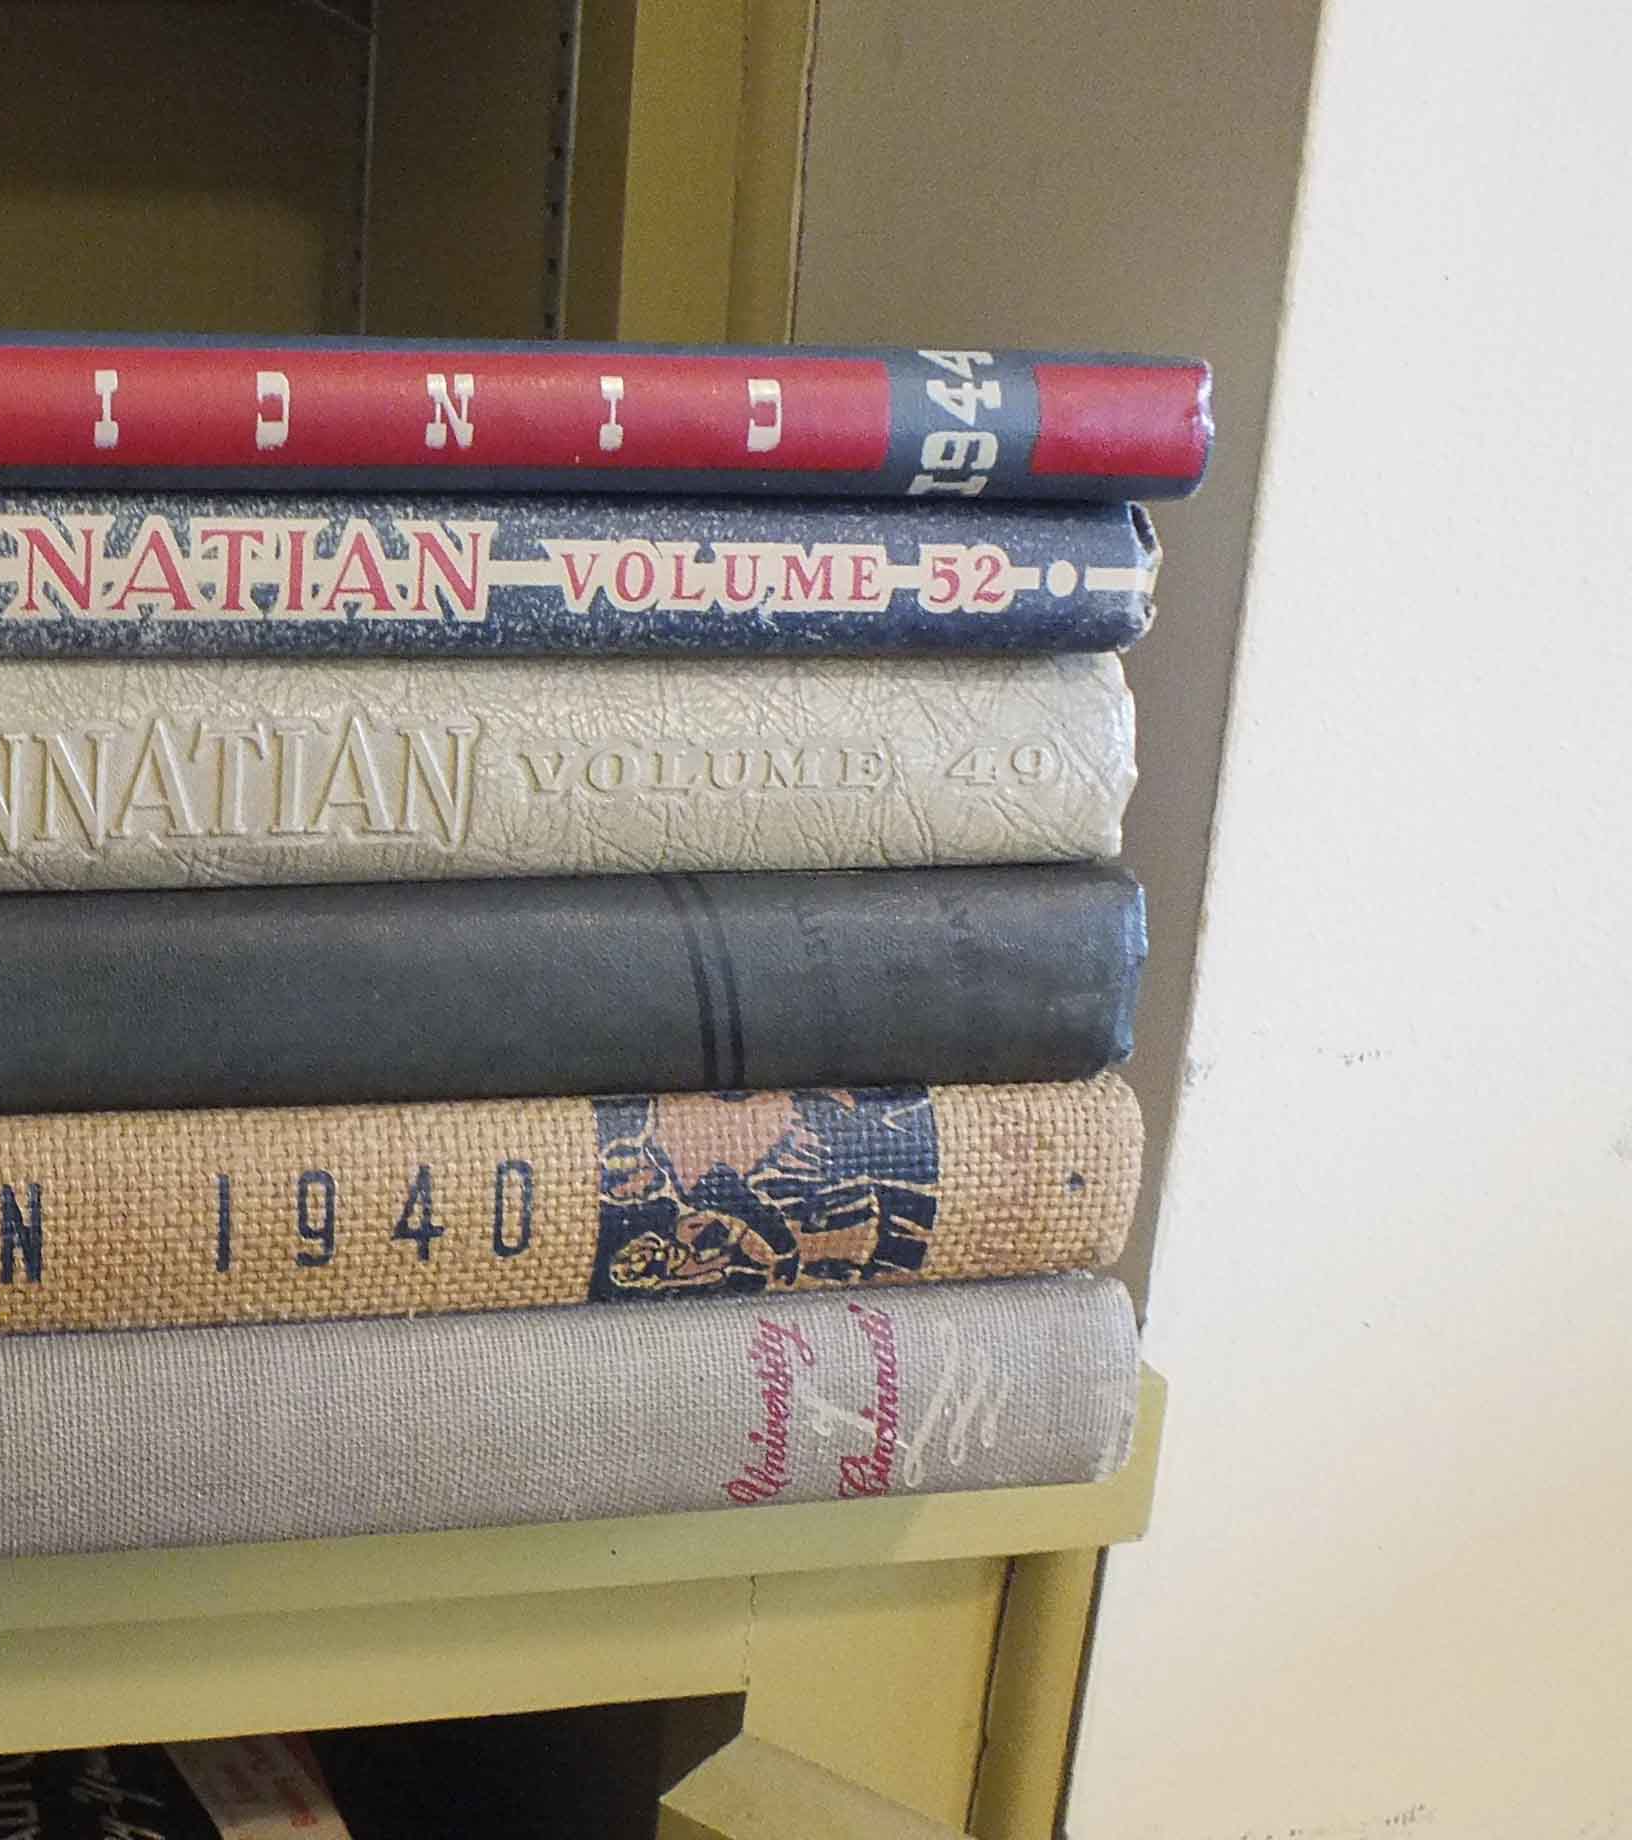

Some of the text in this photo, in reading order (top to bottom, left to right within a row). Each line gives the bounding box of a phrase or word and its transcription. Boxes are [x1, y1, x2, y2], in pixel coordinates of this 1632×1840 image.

[909, 350, 1002, 498] 1944
[560, 551, 883, 602] VOLUME
[928, 554, 1009, 605] 52
[520, 740, 886, 793] VOLUME
[944, 742, 1061, 789] 49
[214, 1158, 535, 1272] 1940
[726, 1317, 815, 1505] University
[838, 1302, 901, 1498] Cincinnati
